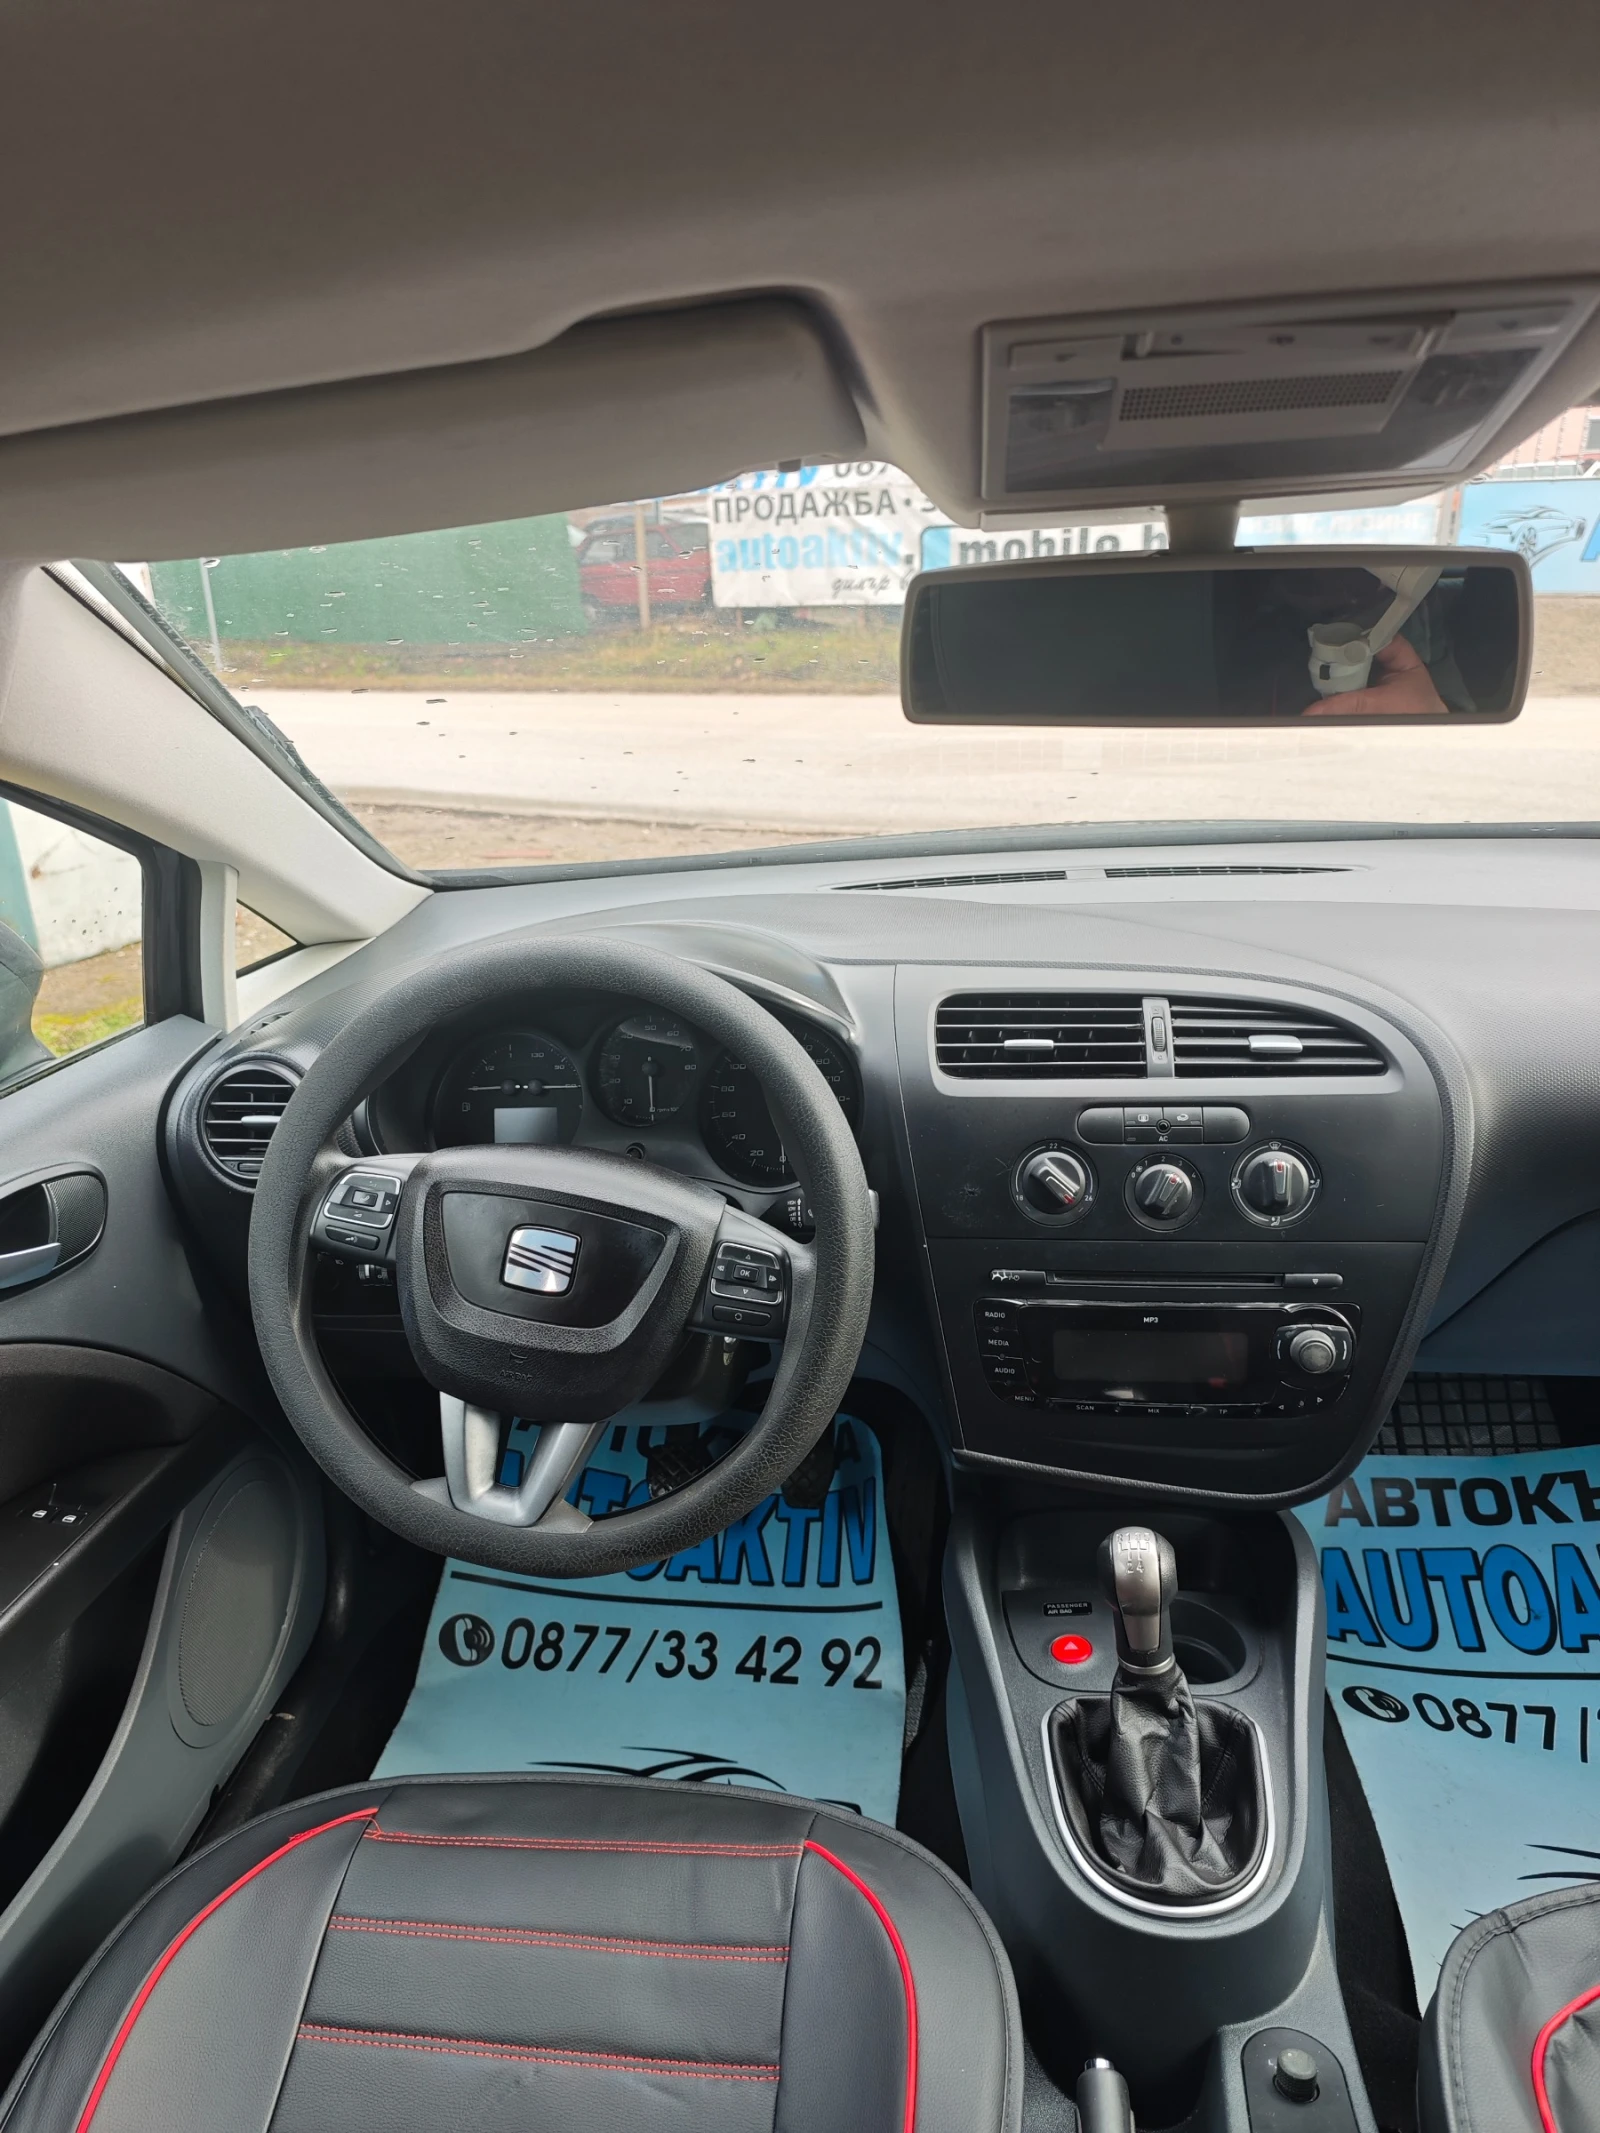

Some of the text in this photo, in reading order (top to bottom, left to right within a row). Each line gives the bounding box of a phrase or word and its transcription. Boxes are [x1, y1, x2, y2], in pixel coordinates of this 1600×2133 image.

[713, 489, 897, 526] ПРОДАЖБА
[739, 1269, 751, 1278] OK
[1143, 1316, 1159, 1324] MP3
[988, 1339, 1010, 1347] MEDIA
[501, 1617, 884, 1689] 0877/33 42 92
